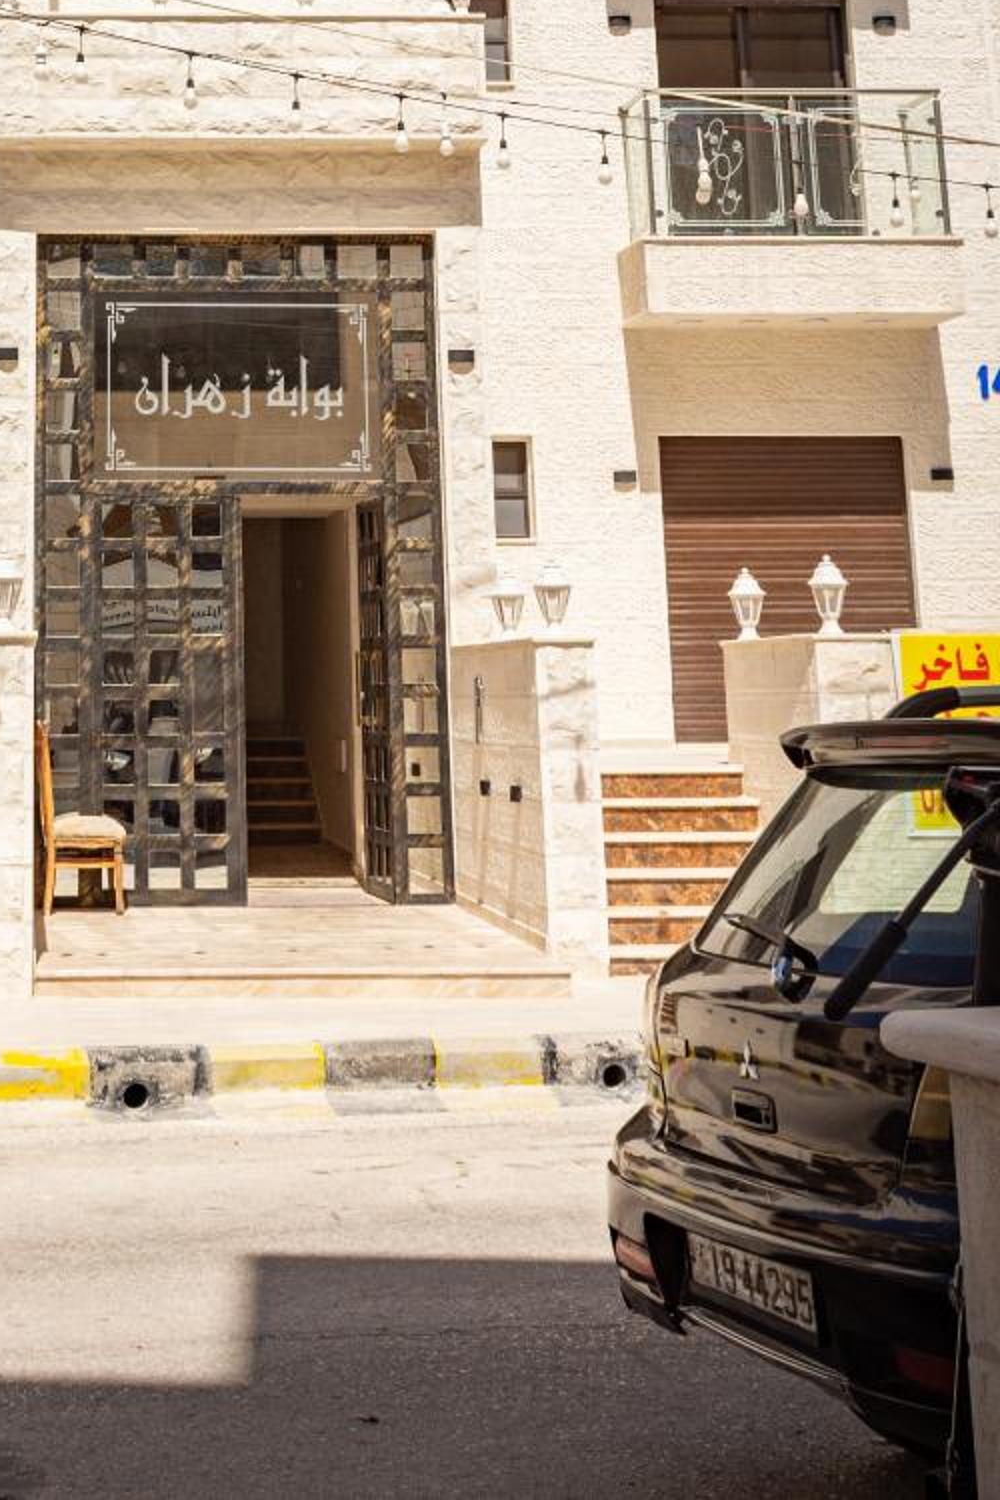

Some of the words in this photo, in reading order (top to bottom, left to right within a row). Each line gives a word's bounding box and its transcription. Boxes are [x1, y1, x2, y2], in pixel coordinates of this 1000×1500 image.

[135, 353, 251, 420] زهران
[266, 354, 344, 420] بوابة
[912, 643, 990, 692] فاخر
